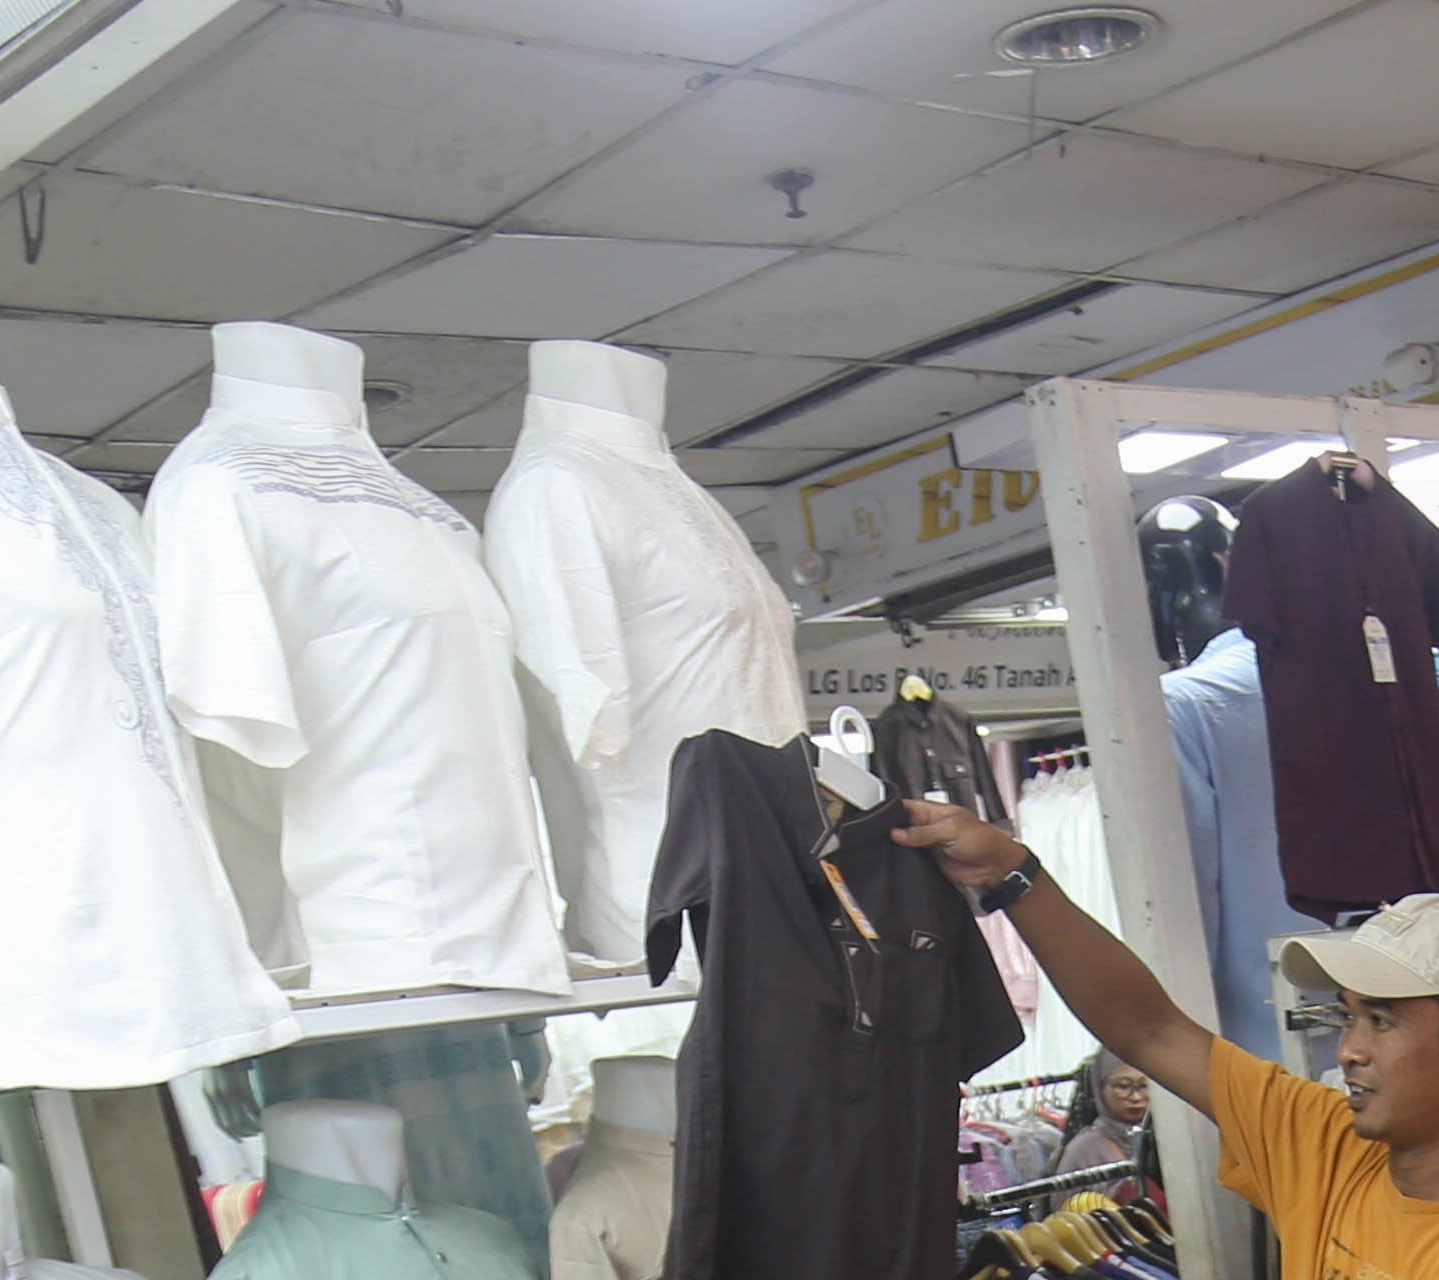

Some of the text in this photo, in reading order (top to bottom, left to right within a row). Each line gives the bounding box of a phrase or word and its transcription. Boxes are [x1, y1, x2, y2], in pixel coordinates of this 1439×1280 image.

[808, 669, 838, 695] LG
[846, 667, 887, 694] Los
[961, 665, 988, 689] 46
[993, 661, 1060, 688] Tanah
